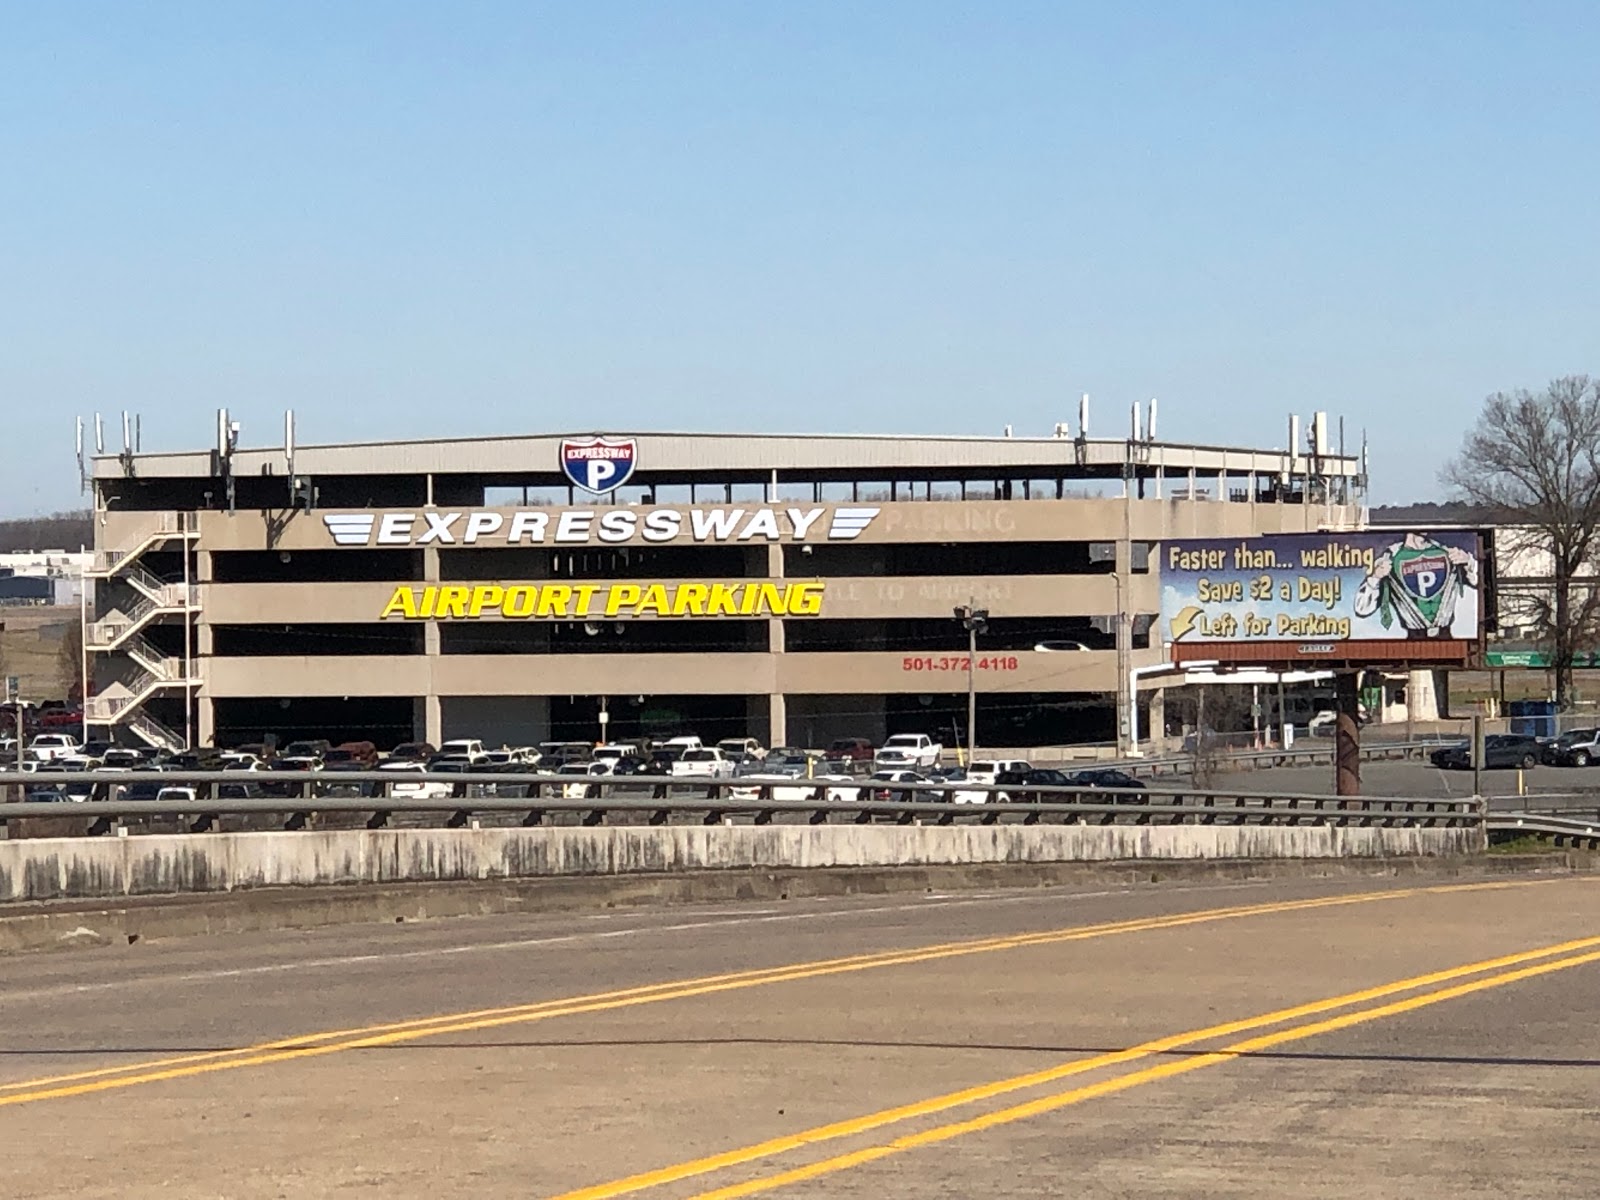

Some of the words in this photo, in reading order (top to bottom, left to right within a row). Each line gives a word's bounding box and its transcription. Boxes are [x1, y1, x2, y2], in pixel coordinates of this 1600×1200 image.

[567, 447, 631, 459] EXPRESSWAY
[587, 460, 615, 490] P
[377, 509, 825, 543] EXPRESSWAY
[1169, 546, 1226, 570] Faster
[1234, 541, 1294, 569] than...
[1300, 542, 1374, 575] walking
[1199, 578, 1243, 601] Save
[1249, 574, 1272, 601] $2
[1280, 581, 1292, 601] a
[1298, 575, 1341, 609] Day!
[1417, 571, 1436, 597] P
[380, 585, 602, 618] AIRPORT
[604, 582, 825, 616] PARKING
[1200, 613, 1237, 637] Left
[1244, 612, 1271, 637] for
[1277, 613, 1350, 639] Parking
[903, 656, 1018, 671] 501-3724118
